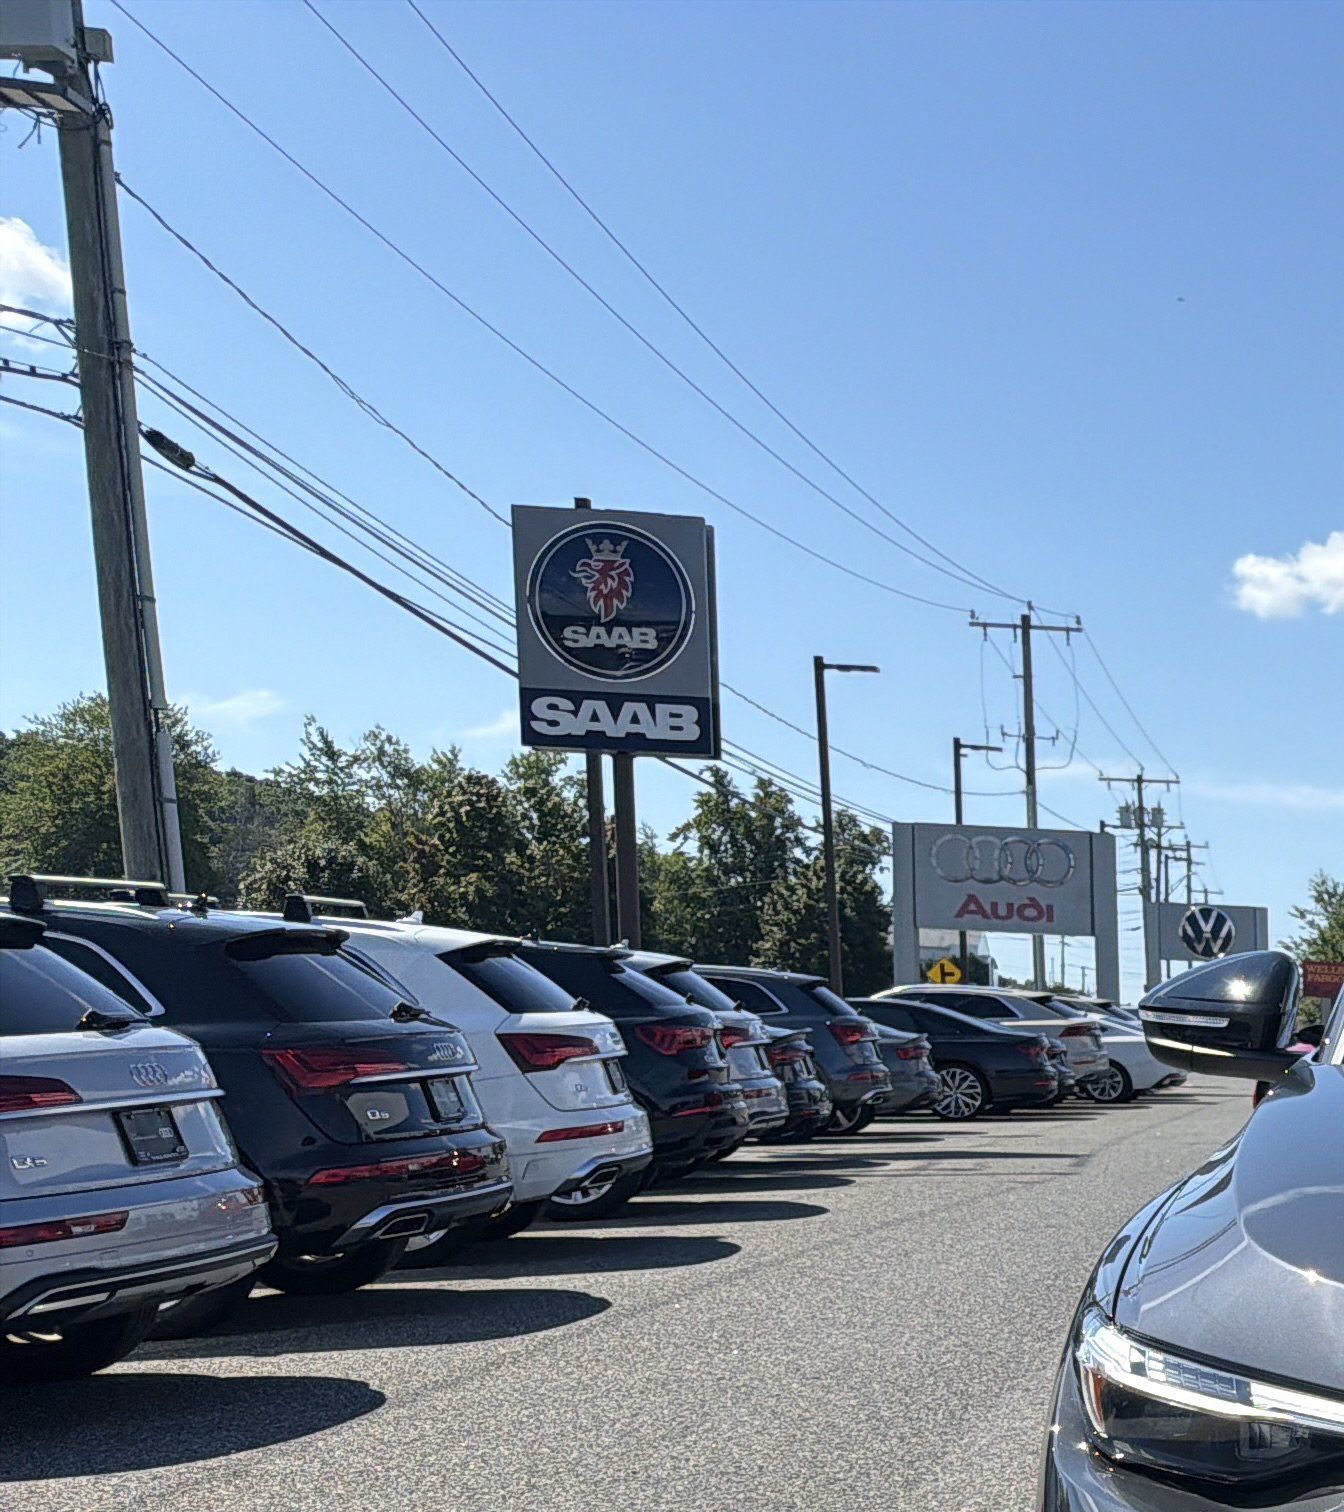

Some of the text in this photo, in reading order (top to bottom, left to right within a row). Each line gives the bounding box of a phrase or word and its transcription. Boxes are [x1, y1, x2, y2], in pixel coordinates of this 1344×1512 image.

[562, 625, 658, 650] SAAB
[529, 696, 701, 741] SAAB
[954, 893, 1055, 923] Audi
